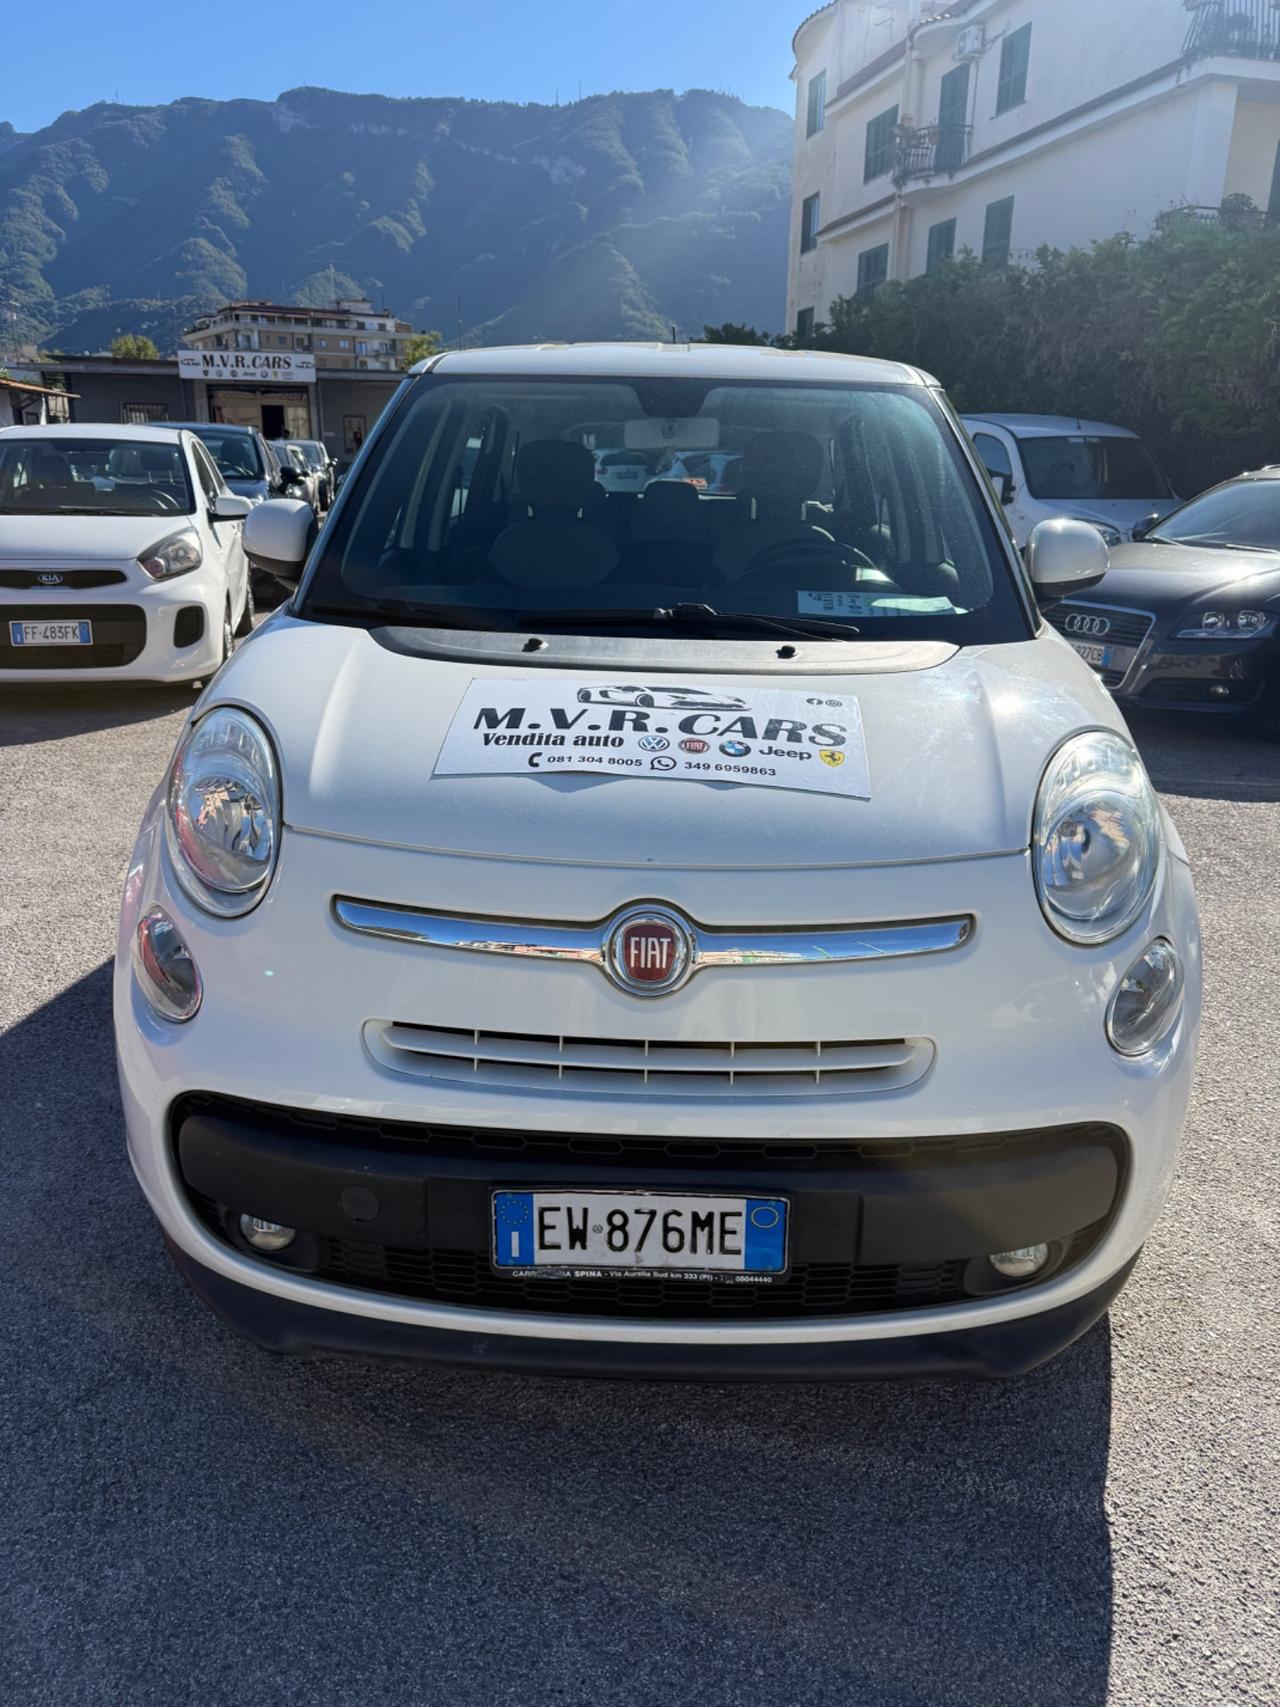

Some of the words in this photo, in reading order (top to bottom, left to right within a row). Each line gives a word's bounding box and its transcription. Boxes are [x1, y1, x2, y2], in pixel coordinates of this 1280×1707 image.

[41, 574, 59, 582] KIA
[483, 733, 566, 747] Vendita
[573, 734, 625, 748] auto
[683, 741, 704, 751] FIAT
[759, 745, 812, 761] Jeep
[547, 755, 573, 764] 081
[577, 755, 603, 765] 304
[607, 757, 642, 767] 8005
[684, 761, 711, 771] 349
[714, 763, 776, 777] 6959863
[630, 936, 671, 969] FIAT
[574, 1270, 602, 1278] SPINA
